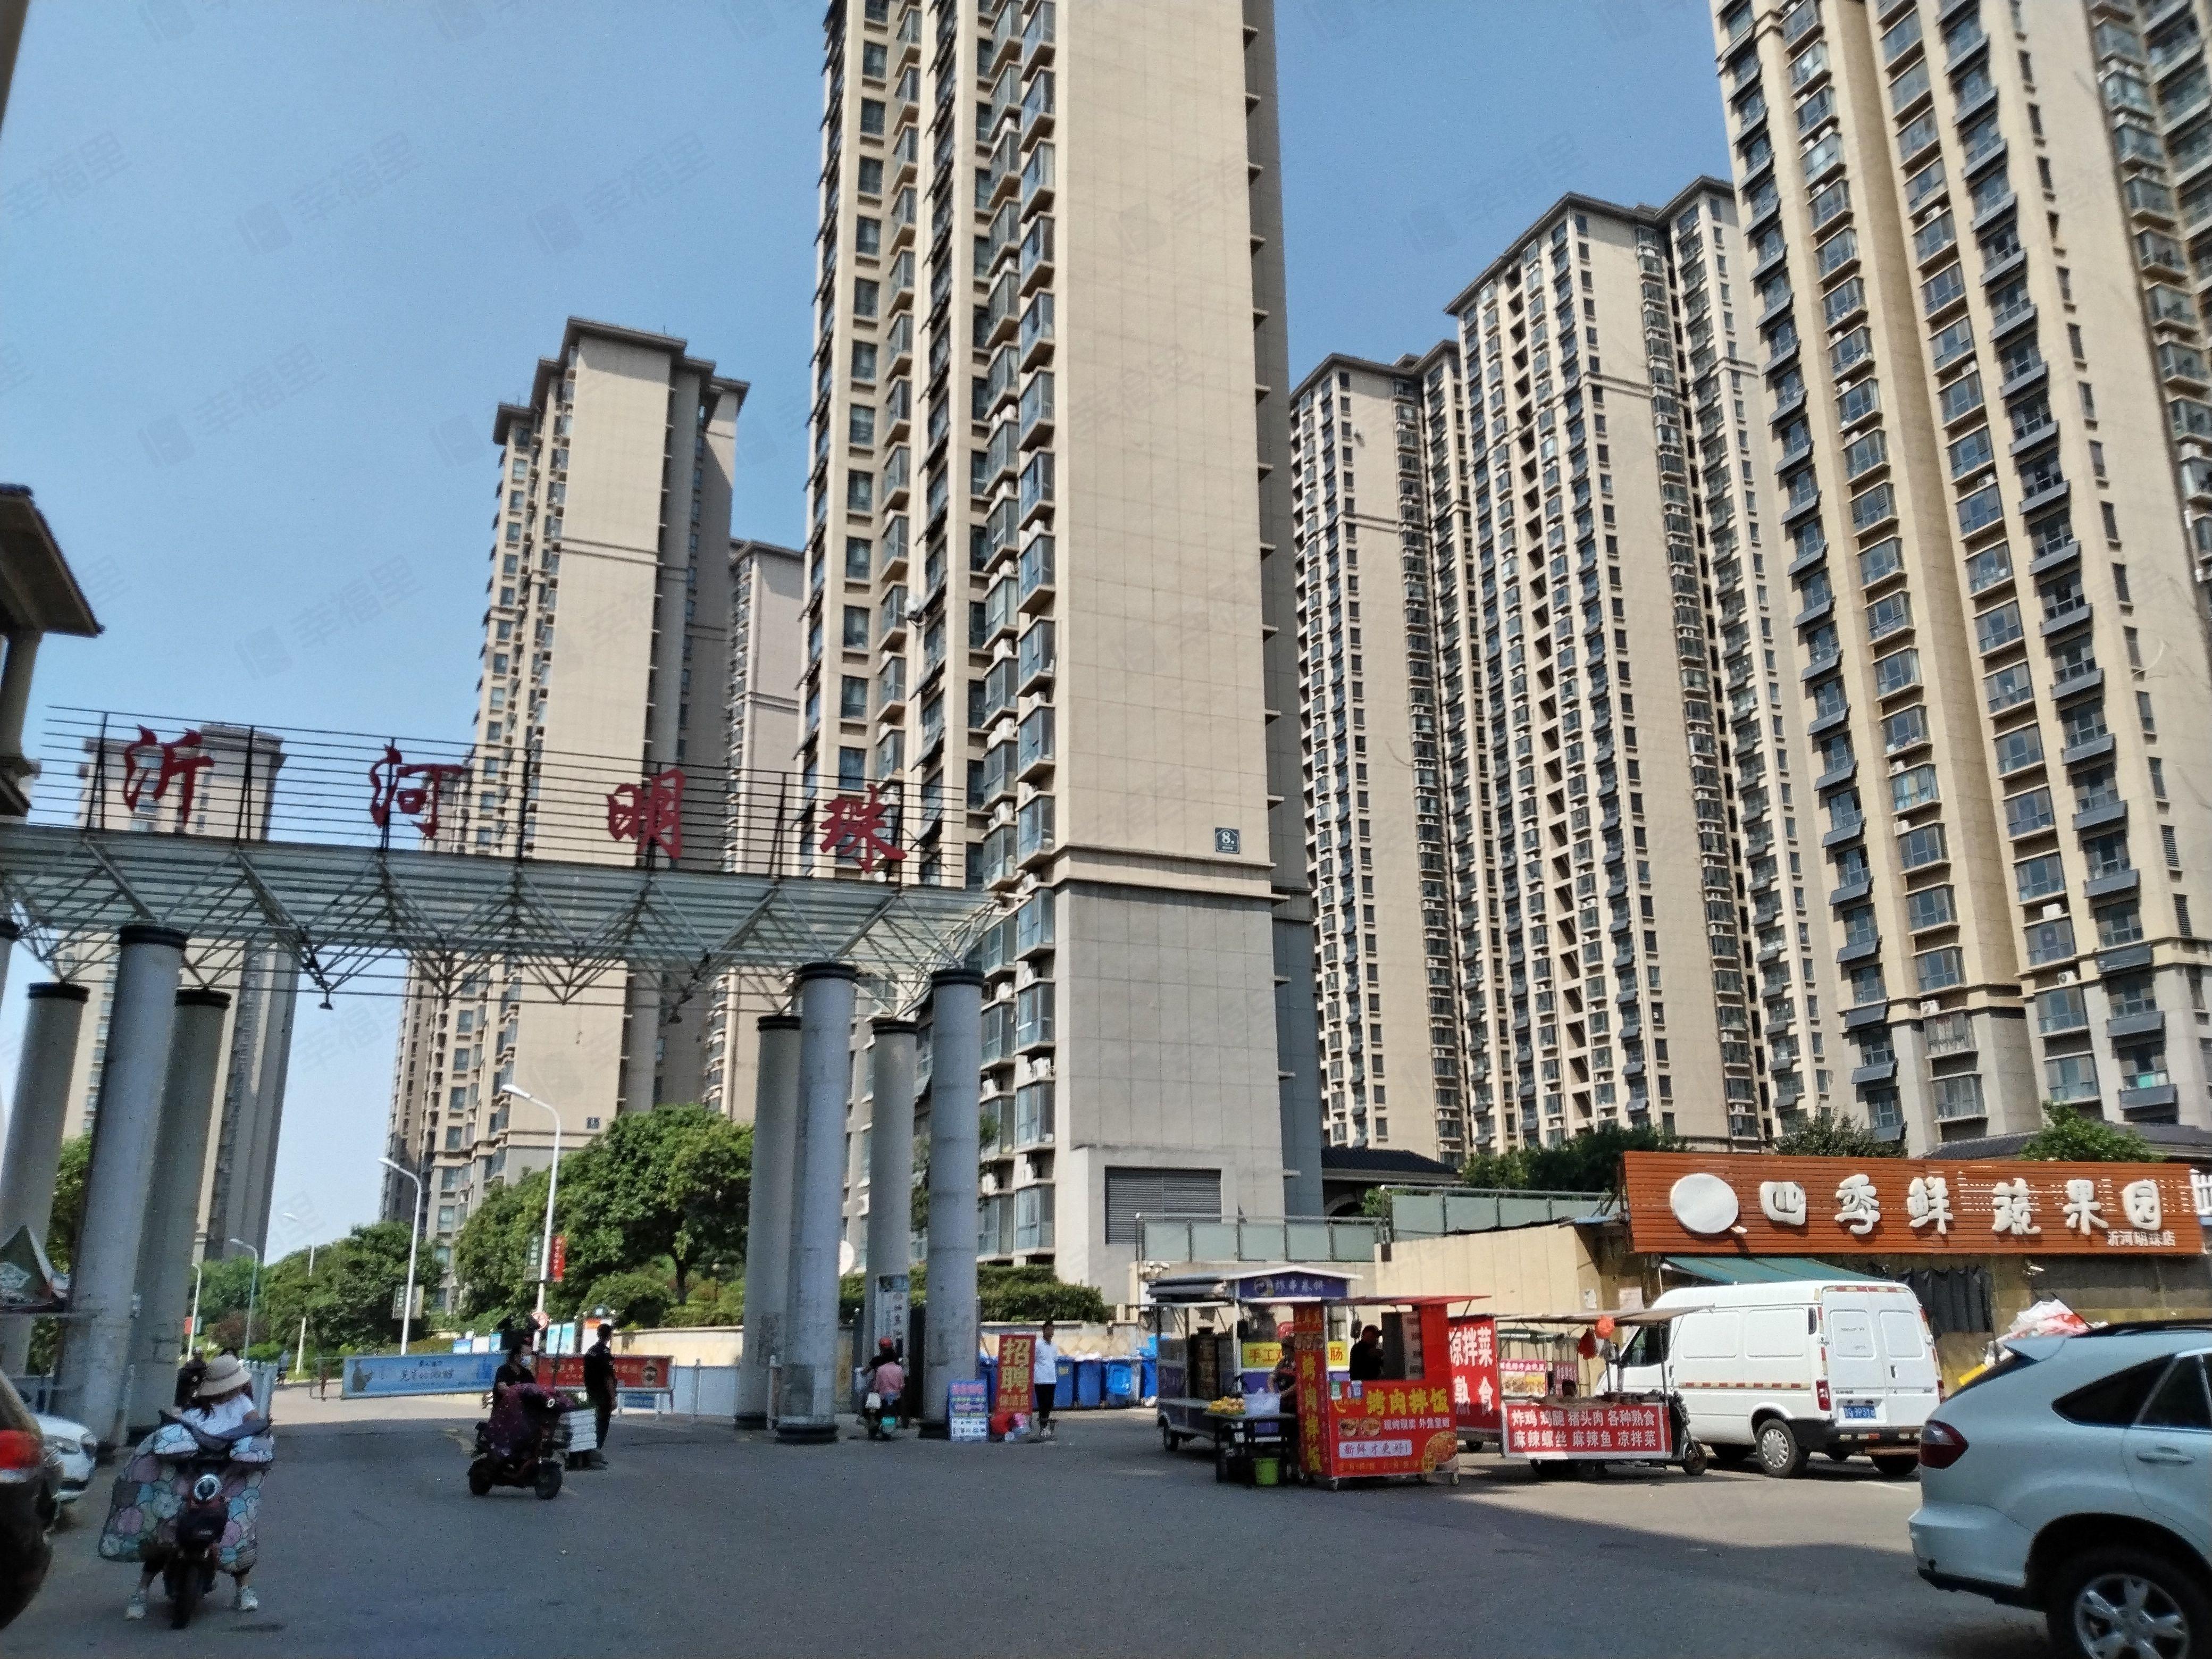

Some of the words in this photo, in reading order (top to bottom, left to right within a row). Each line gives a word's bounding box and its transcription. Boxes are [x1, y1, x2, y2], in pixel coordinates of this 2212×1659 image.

[123, 724, 908, 874] 沂河明珠
[1759, 1174, 2163, 1236] 四季鲜蔬果园
[2107, 1230, 2176, 1247] 沂河明珠店
[1000, 1338, 1031, 1393] 招聘
[1367, 1387, 1449, 1415] 烤肉拌饭
[1511, 1409, 1537, 1427] 炸鸡
[1608, 1410, 1655, 1427] 各种熟食
[1618, 1430, 1656, 1447] 凉拌菜
